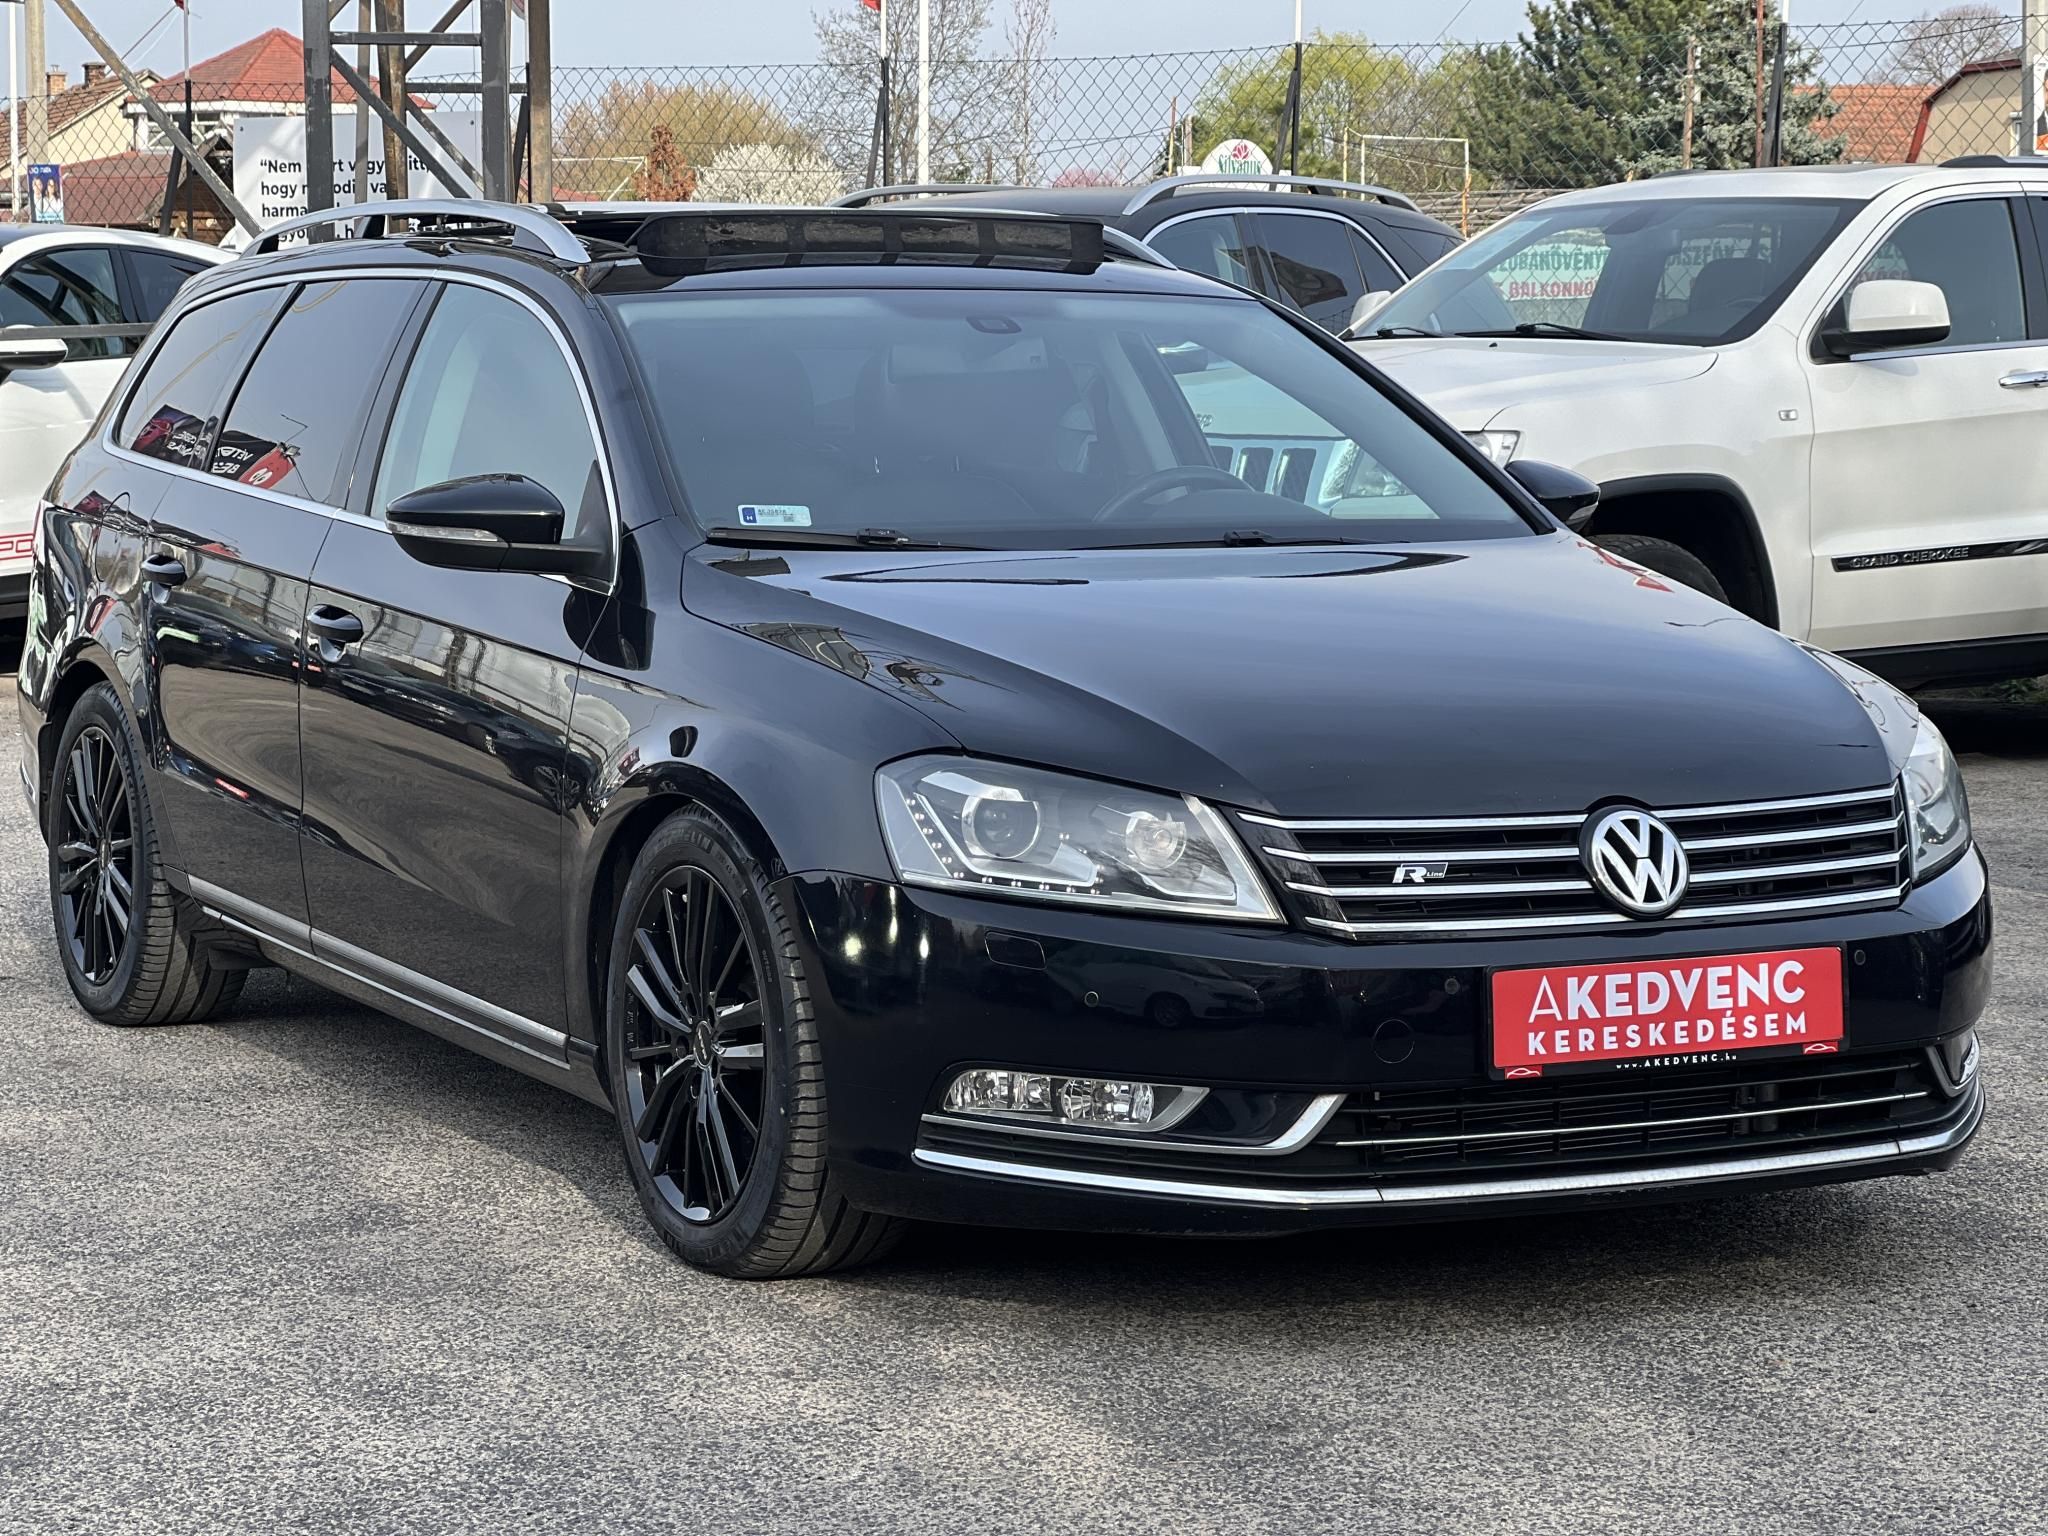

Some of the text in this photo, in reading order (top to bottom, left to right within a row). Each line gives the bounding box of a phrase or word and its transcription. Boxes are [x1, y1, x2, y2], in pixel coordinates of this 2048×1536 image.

[350, 160, 384, 175] vgy
[261, 181, 298, 199] hogy
[1852, 547, 1969, 567] GRAND CHEROKEE
[1528, 1008, 1807, 1056] KERESKEDÉSEM
[1616, 1053, 1737, 1069] www.AKEDVENC.hu
